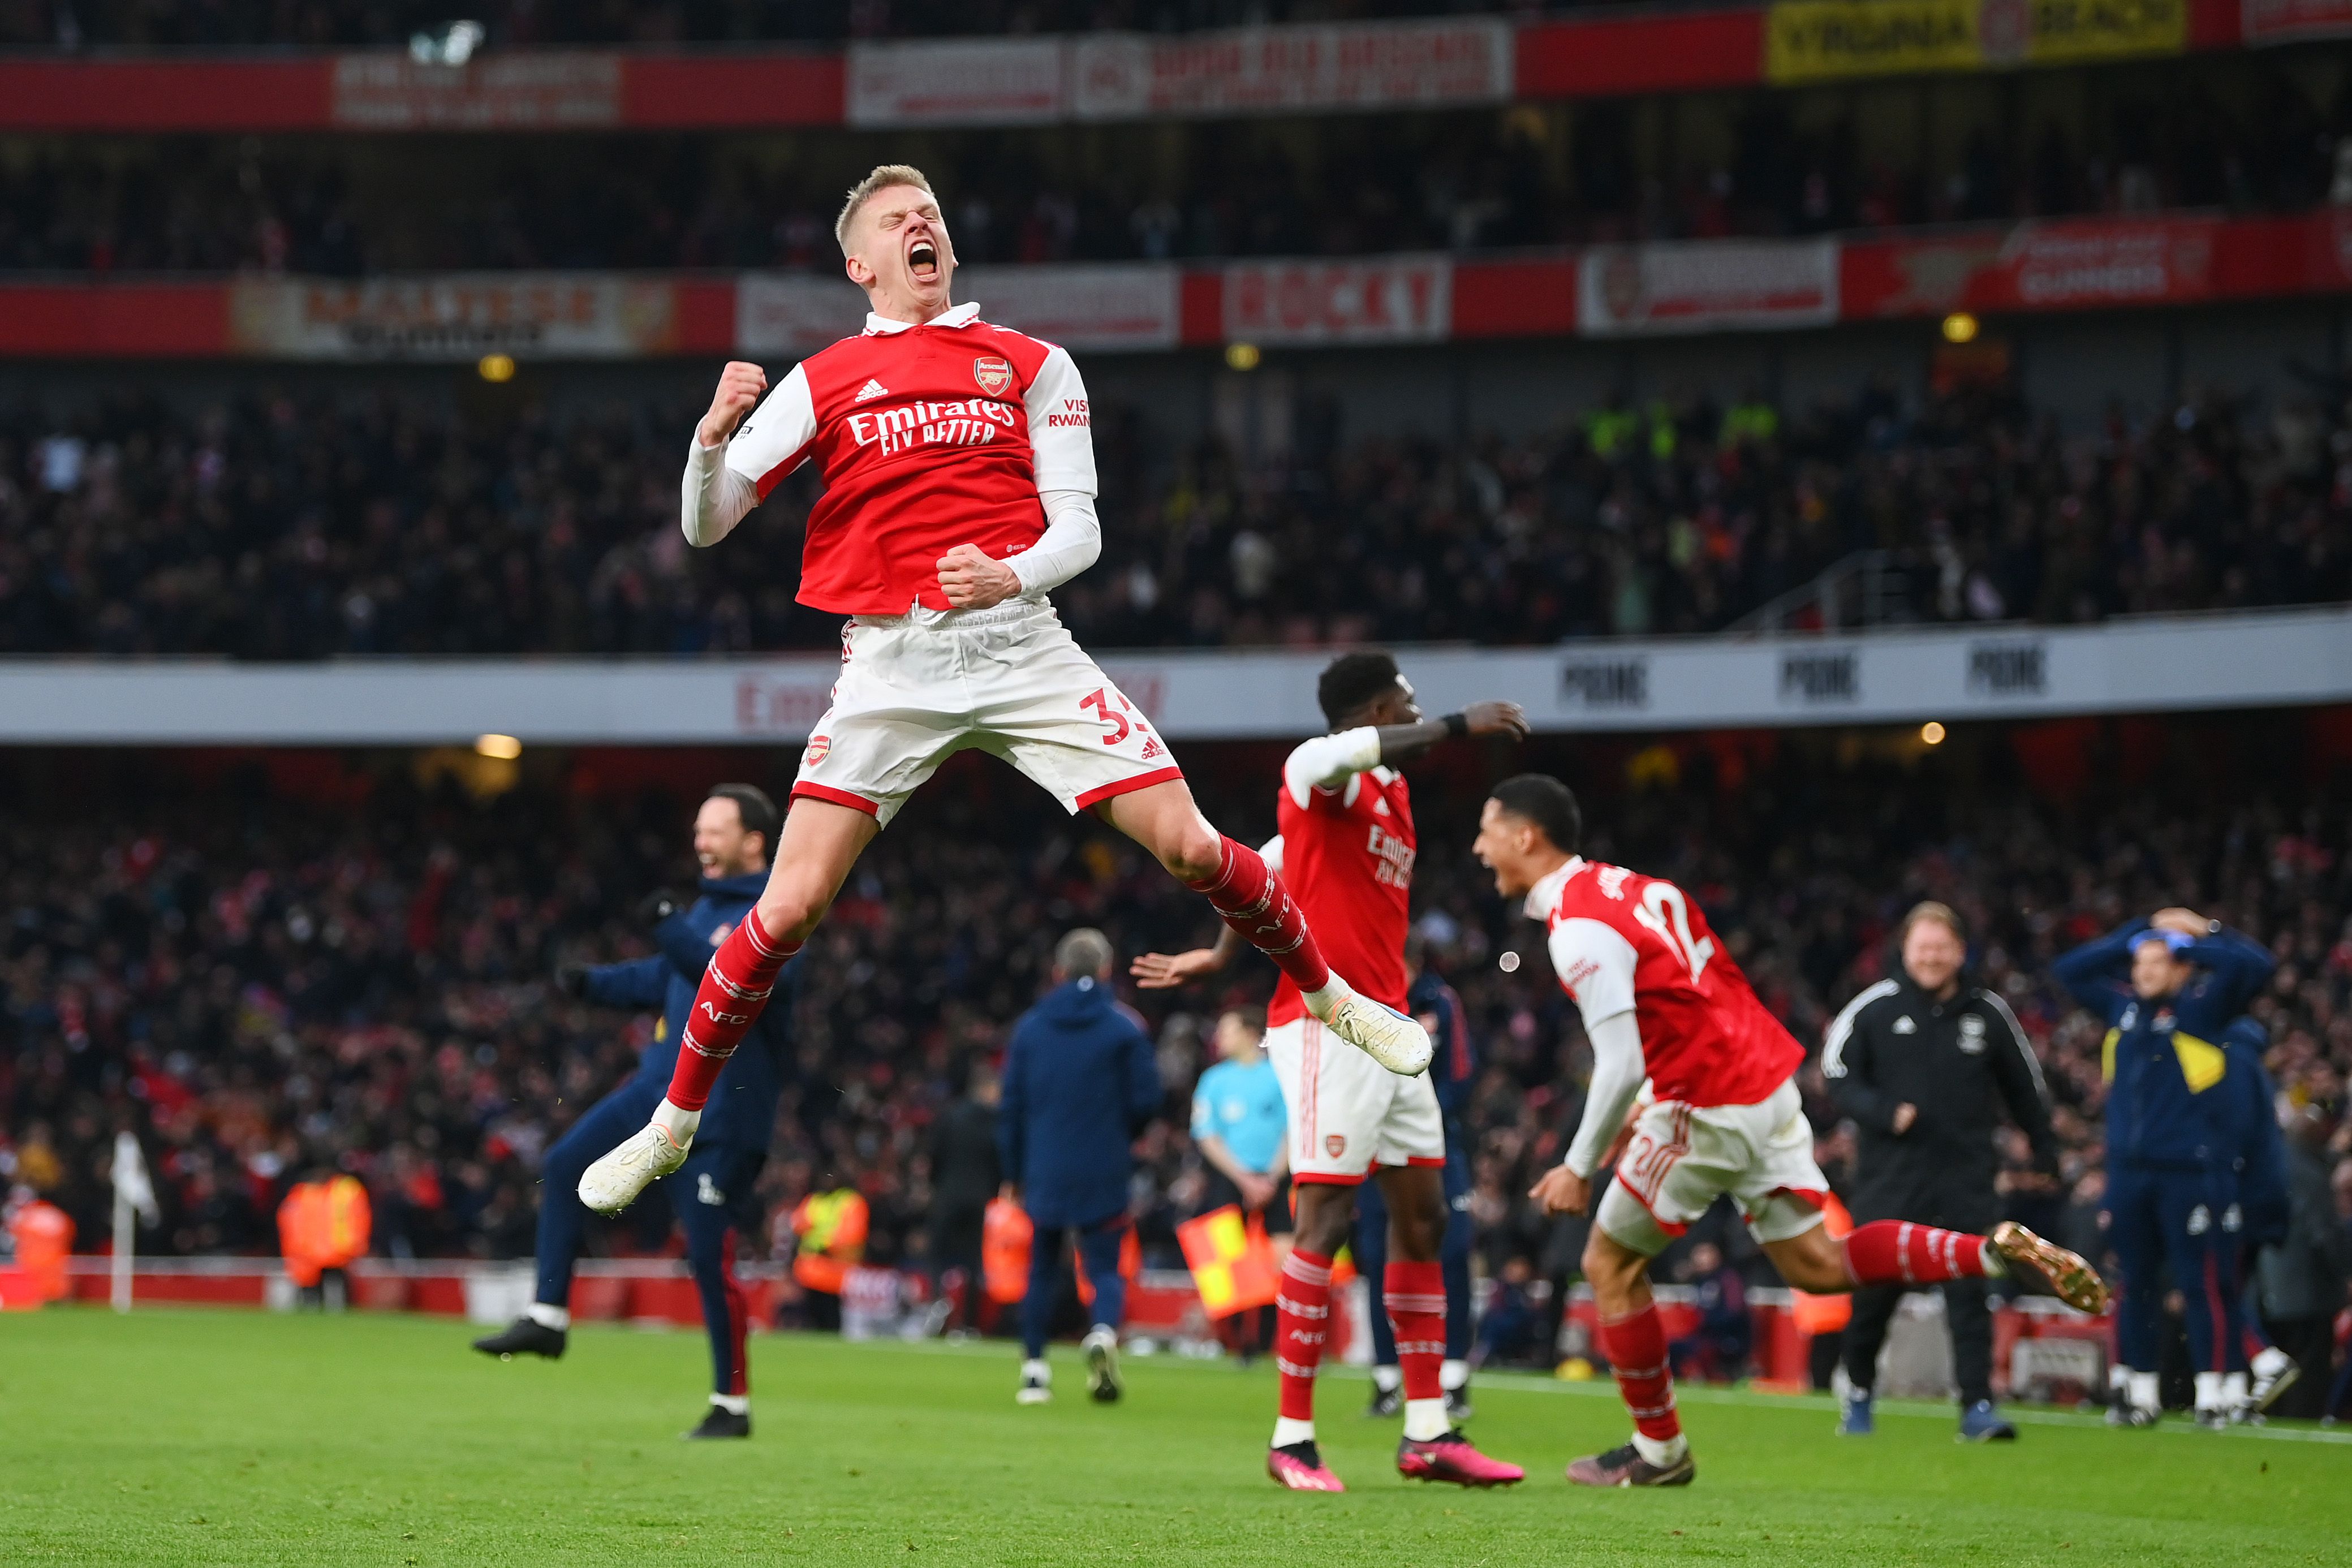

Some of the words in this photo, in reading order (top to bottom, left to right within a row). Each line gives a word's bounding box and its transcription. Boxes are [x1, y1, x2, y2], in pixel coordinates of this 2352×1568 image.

[1237, 262, 1437, 328] ROCKY
[855, 389, 889, 402] adidas
[1064, 399, 1088, 413] VISI
[847, 399, 1015, 446] Emirates
[1049, 414, 1090, 427] RWAN
[700, 1001, 748, 1024] AFC
